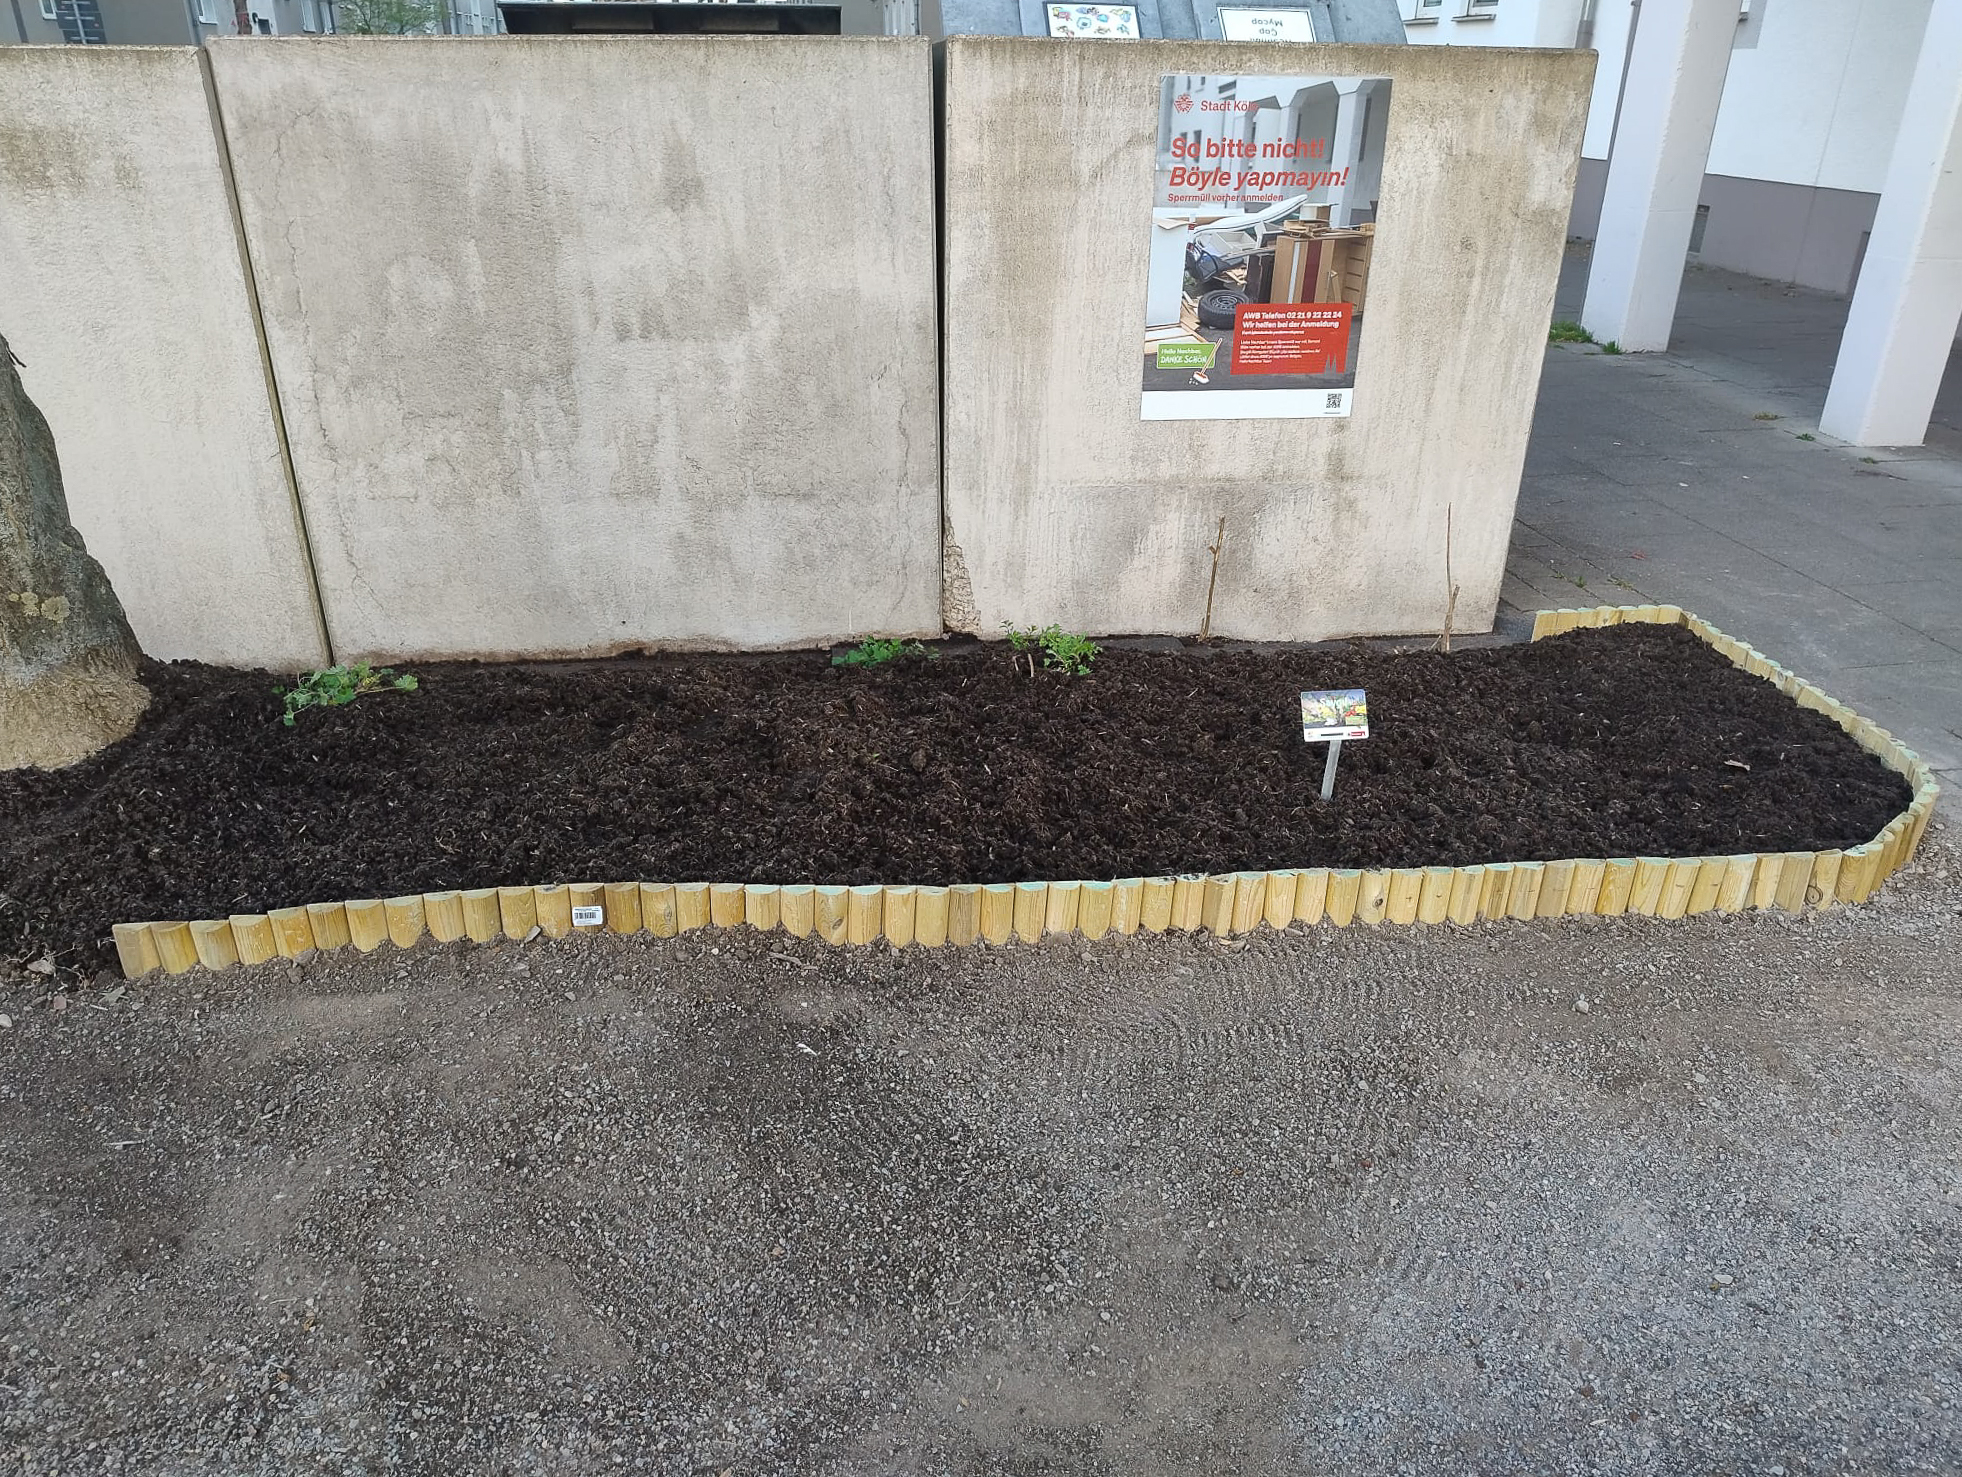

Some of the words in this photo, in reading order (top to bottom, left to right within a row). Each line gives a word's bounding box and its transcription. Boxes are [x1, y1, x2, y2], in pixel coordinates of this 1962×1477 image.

[1200, 100, 1231, 112] Stadt
[1171, 138, 1201, 158] So
[1206, 137, 1257, 158] bitte
[1262, 138, 1326, 158] nicht!
[1169, 166, 1232, 191] Böyle
[1167, 193, 1211, 203] Sperrmüll
[1211, 193, 1240, 202] vorher
[1240, 193, 1284, 202] anmelden
[1243, 311, 1261, 319] AWB
[1261, 311, 1286, 319] Telefon
[1242, 320, 1255, 328] Wir
[1255, 320, 1277, 328] helfen
[1277, 320, 1289, 328] bei
[1289, 320, 1301, 328] der
[1300, 320, 1340, 329] Anmeldung
